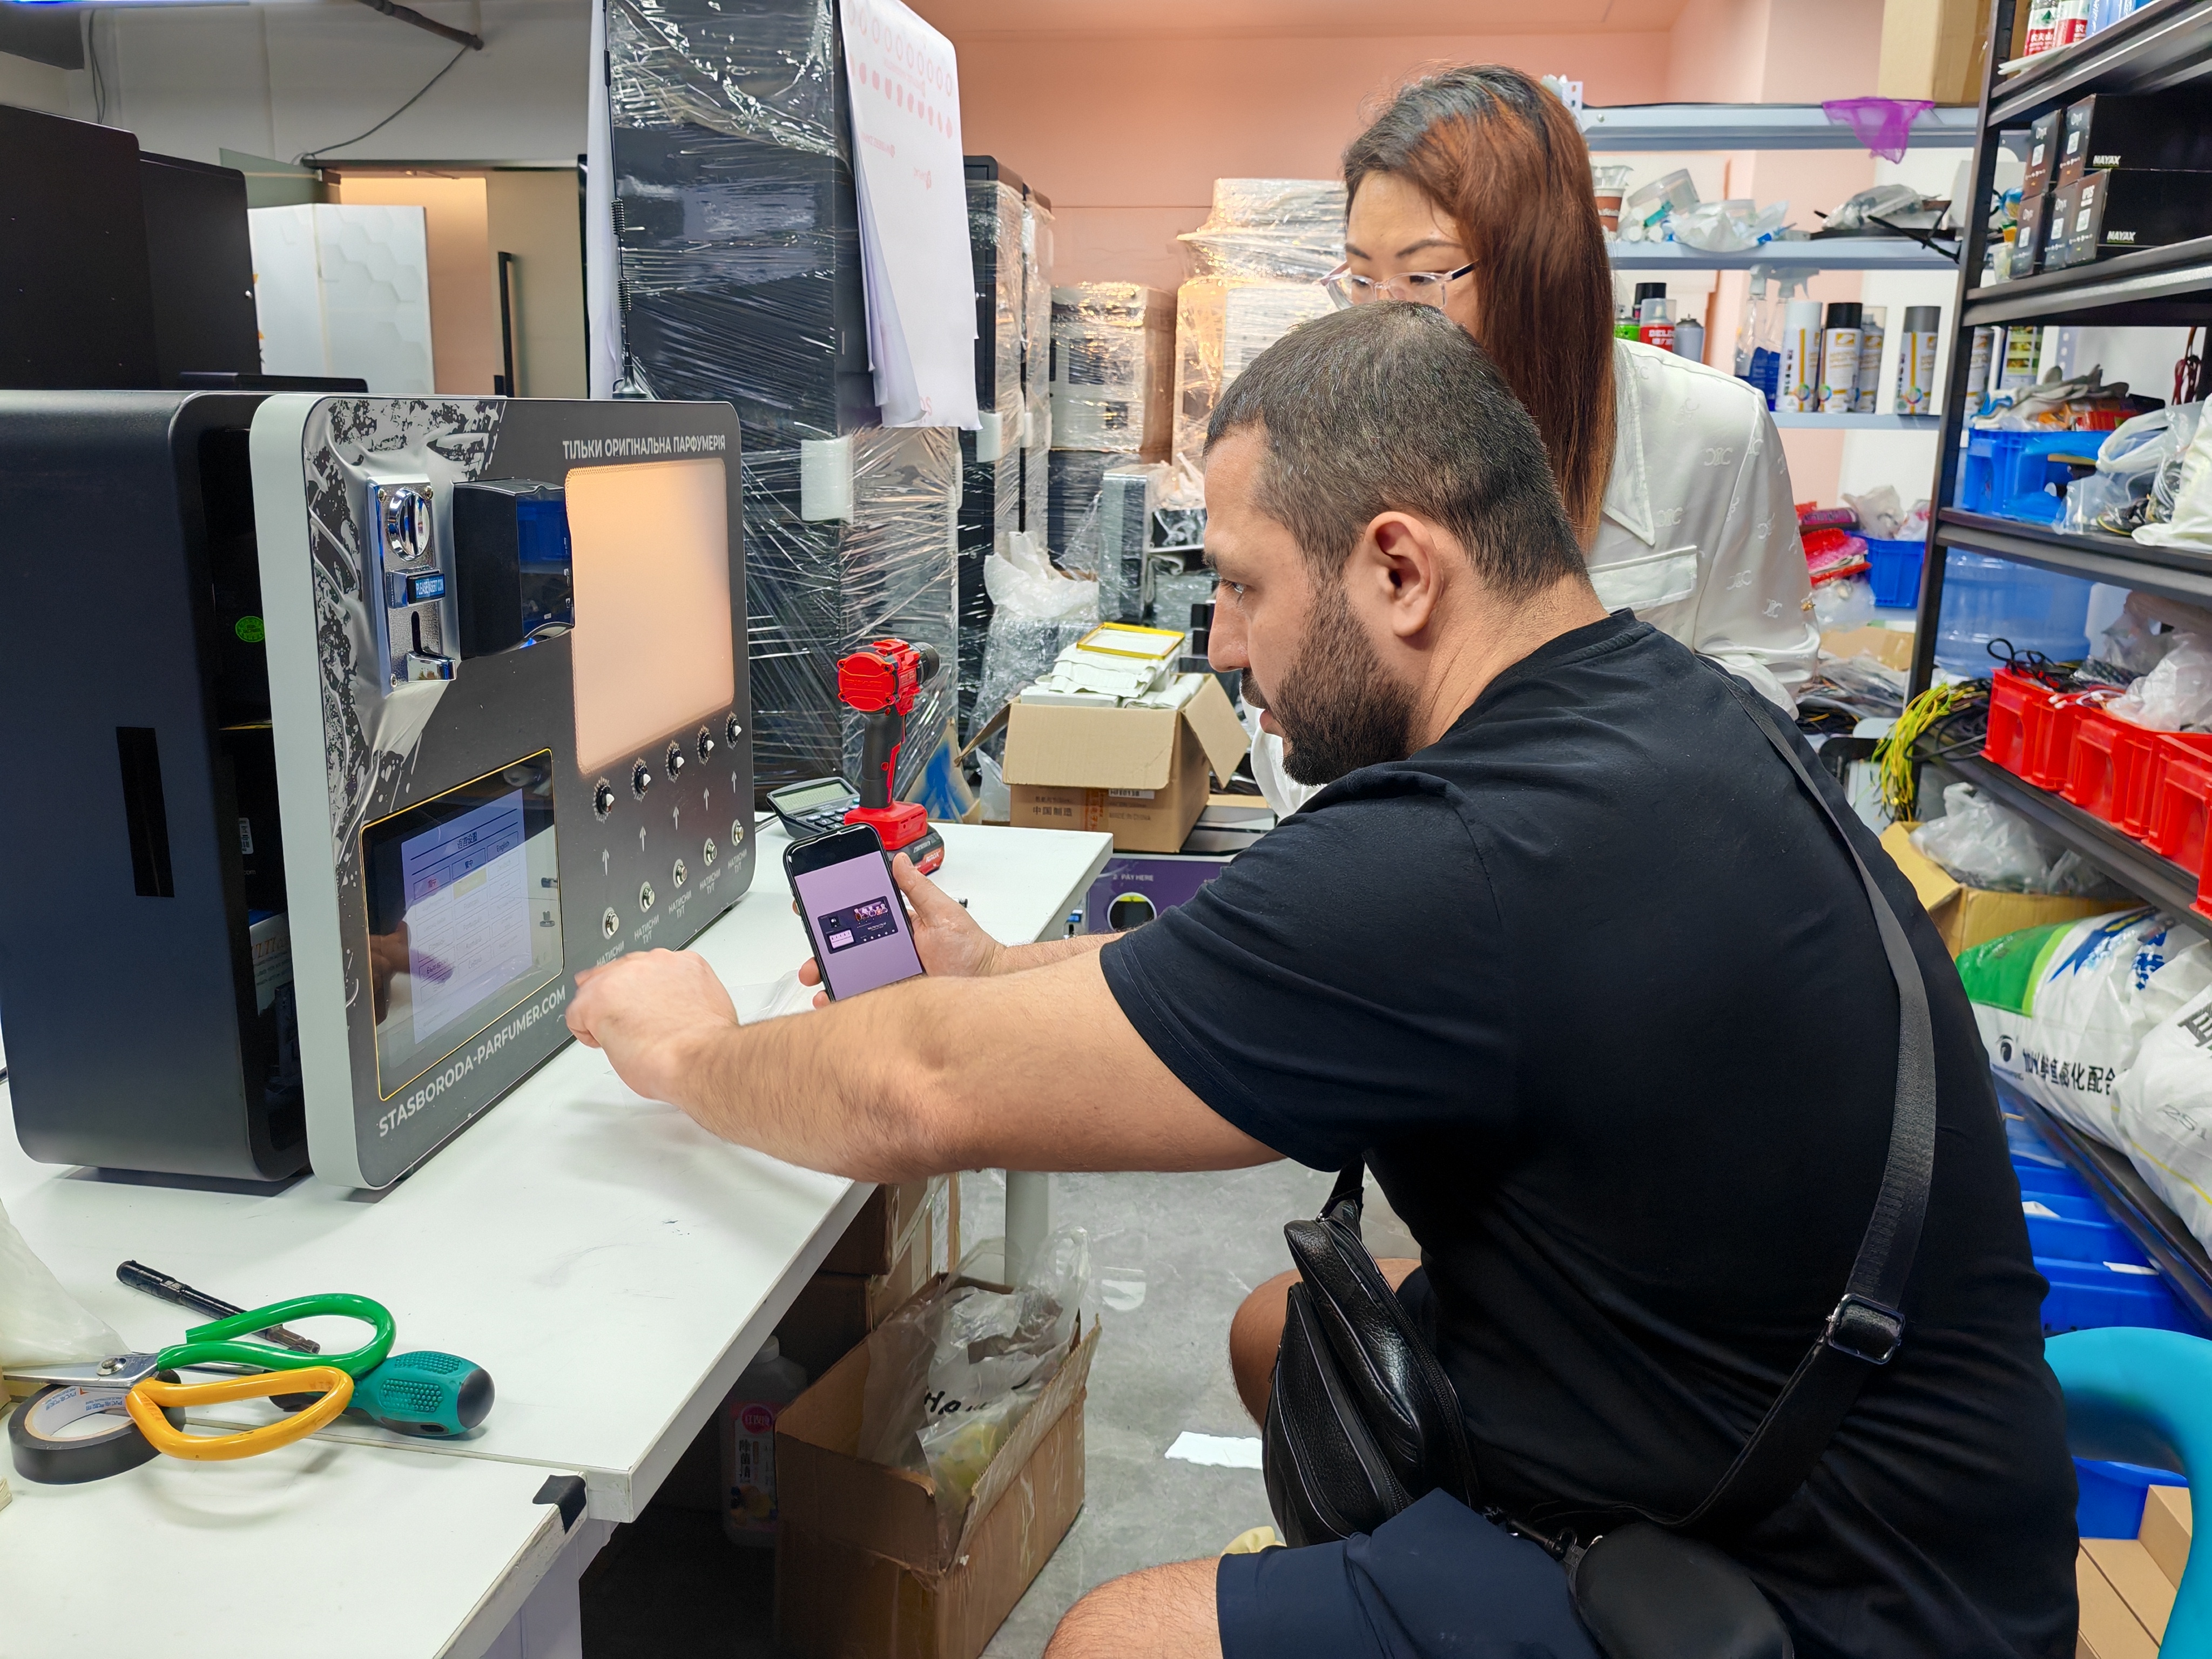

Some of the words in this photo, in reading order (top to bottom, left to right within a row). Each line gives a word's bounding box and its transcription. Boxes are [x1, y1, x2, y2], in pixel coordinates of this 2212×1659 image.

[2093, 155, 2122, 165] NAYAX
[2107, 231, 2136, 241] NAYAX
[562, 439, 603, 460] ТІЛЬКИ
[604, 436, 672, 457] ОРИГІНАЛЬНА
[673, 434, 726, 453] ПАРФУМЕРІЯ
[1033, 806, 1073, 817] 中国制造
[496, 840, 510, 853] English
[727, 848, 747, 869] НАТИСНИ
[699, 868, 721, 891] НАТИСНИ
[706, 881, 714, 895] ТУТ
[668, 889, 692, 914] НАТИСНИ
[676, 906, 685, 919] ТУТ
[634, 914, 659, 941] НАТИСНИ
[643, 930, 652, 944] ТУТ
[596, 940, 624, 968] НАТИСНИ
[379, 984, 566, 1137] STASBORODA-PARFUMER.COM
